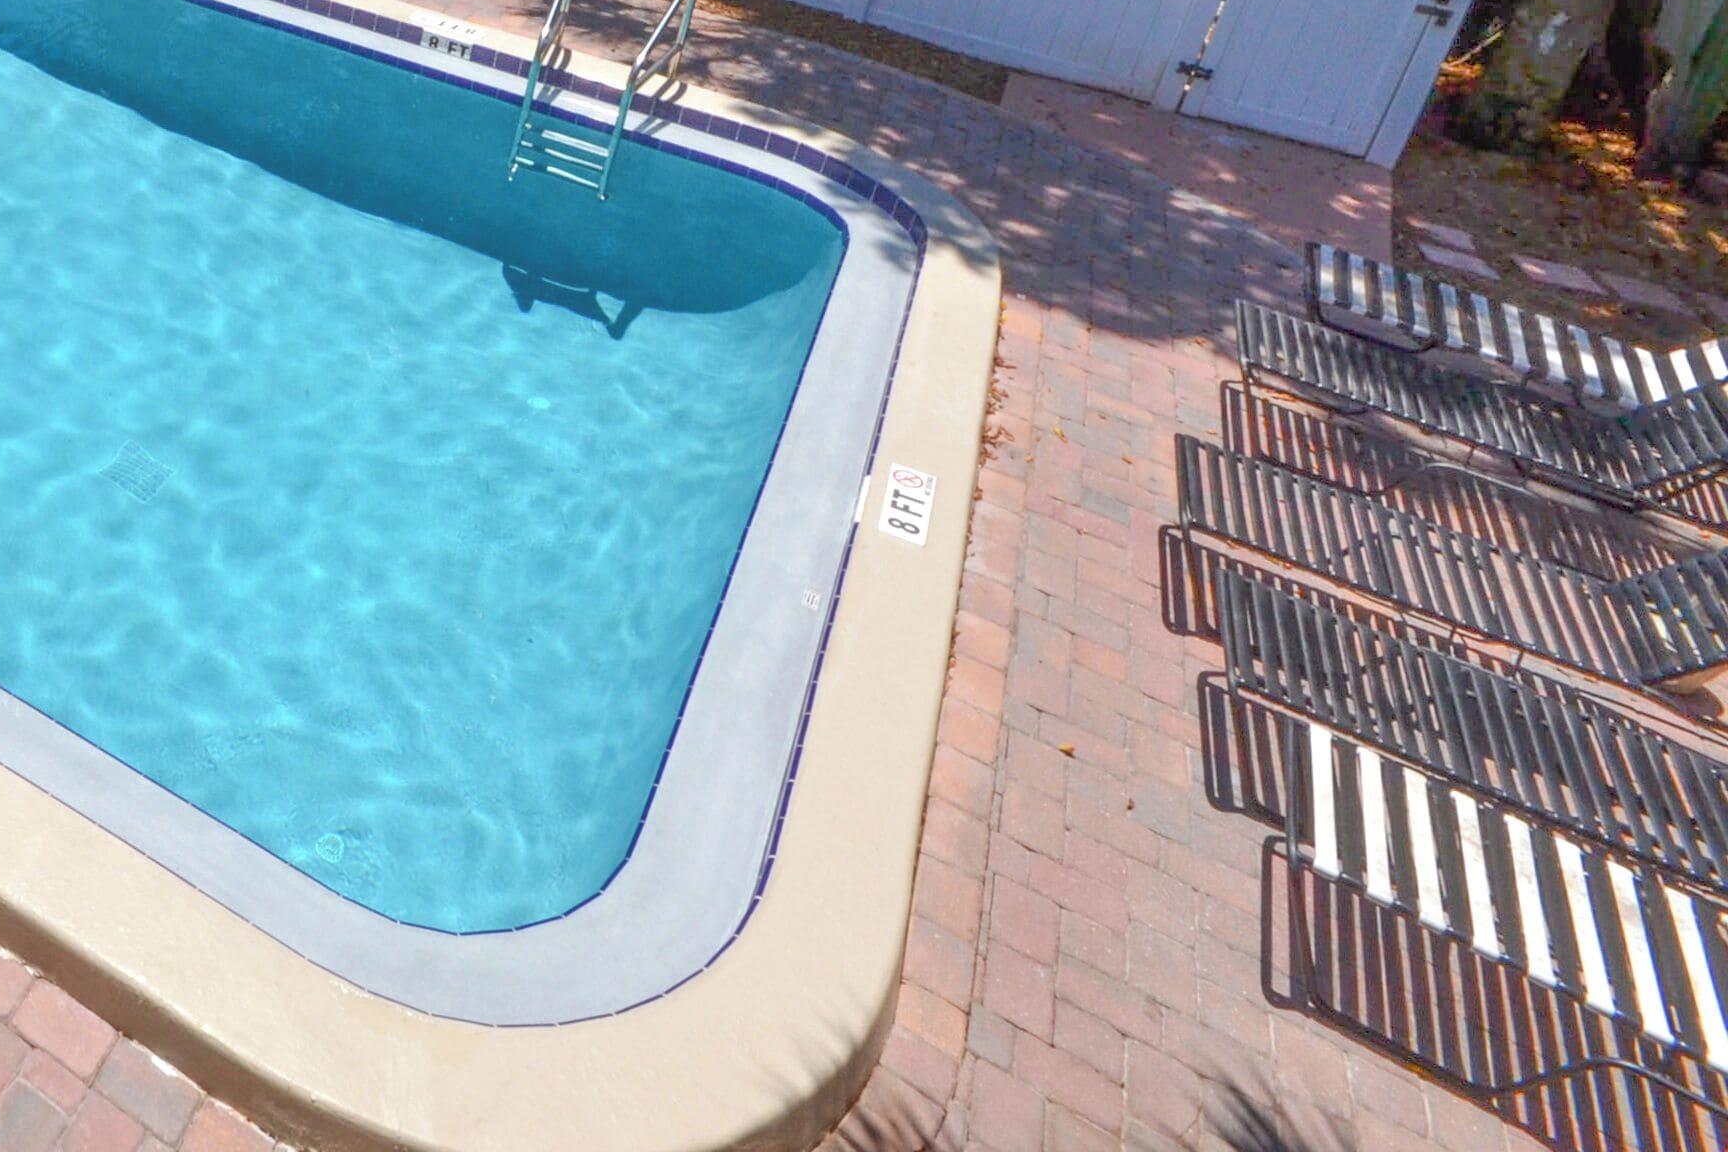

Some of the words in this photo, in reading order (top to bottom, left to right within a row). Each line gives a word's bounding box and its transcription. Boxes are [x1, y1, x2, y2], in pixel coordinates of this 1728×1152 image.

[448, 41, 470, 57] FT
[890, 489, 925, 518] FT
[887, 517, 920, 535] 8
